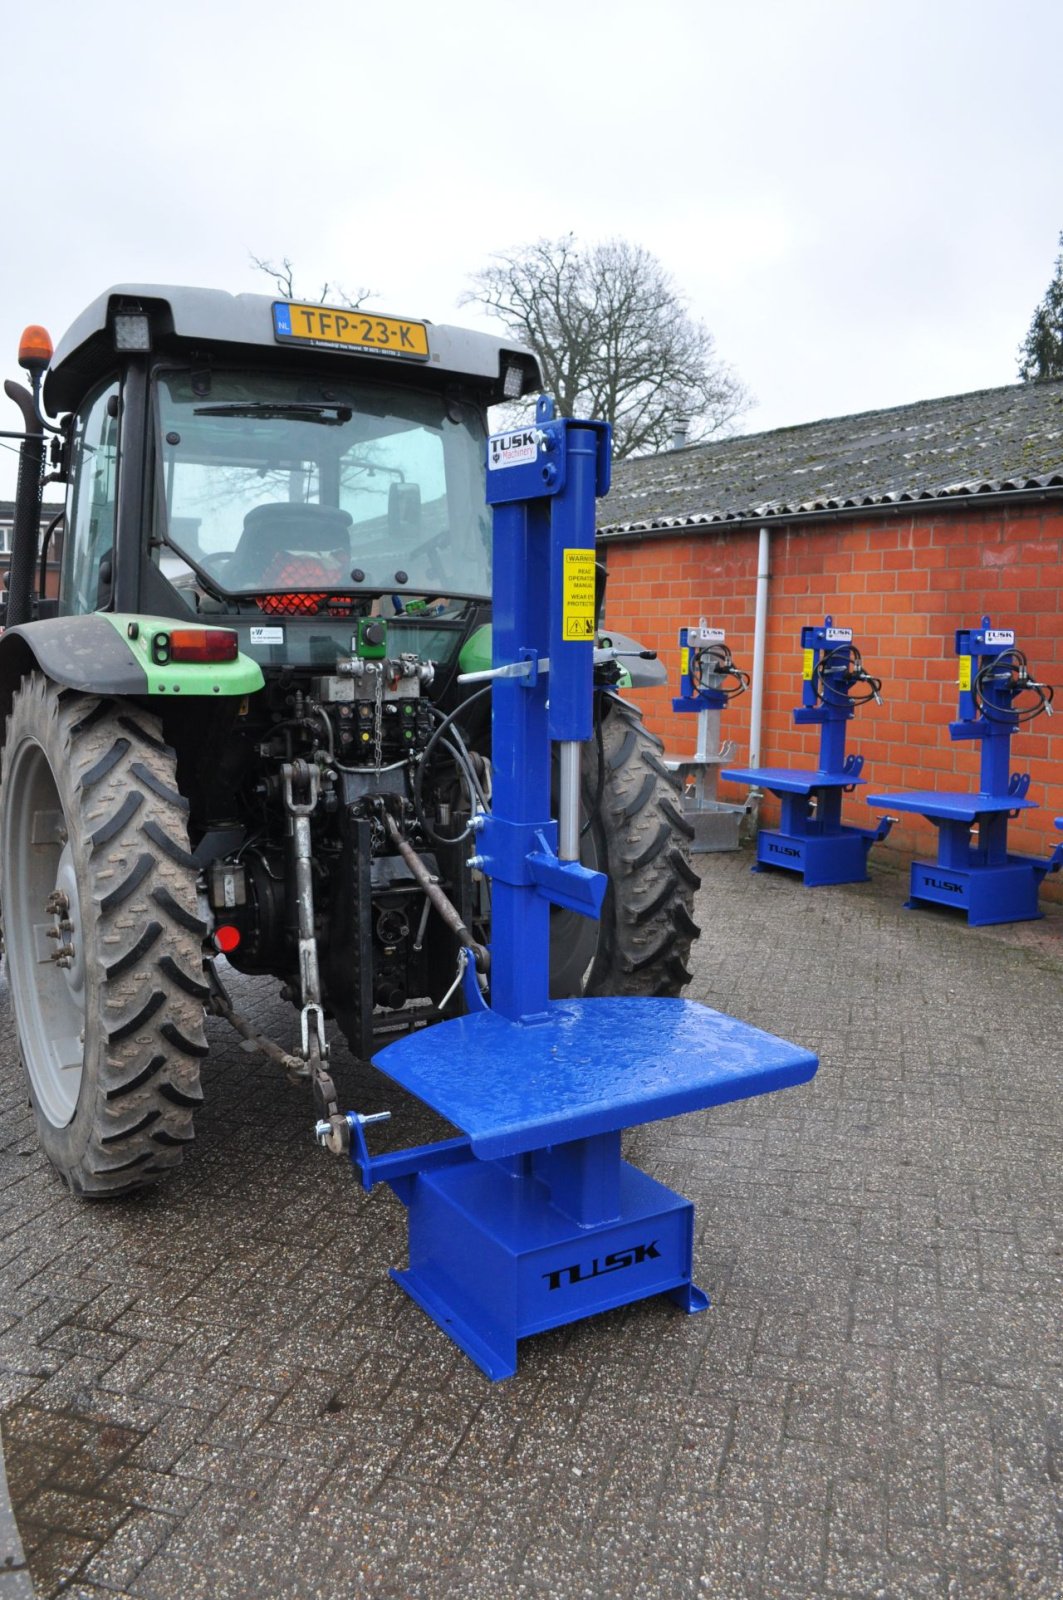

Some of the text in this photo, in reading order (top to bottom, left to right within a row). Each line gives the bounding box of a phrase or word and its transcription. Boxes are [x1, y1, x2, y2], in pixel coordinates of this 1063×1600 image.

[278, 322, 290, 330] NL
[300, 310, 415, 348] TFP-23-K
[490, 431, 535, 453] TUSK
[502, 447, 534, 459] Machinery
[768, 843, 801, 858] TUSK
[923, 876, 964, 895] TUSK
[541, 1239, 662, 1291] TUSK
